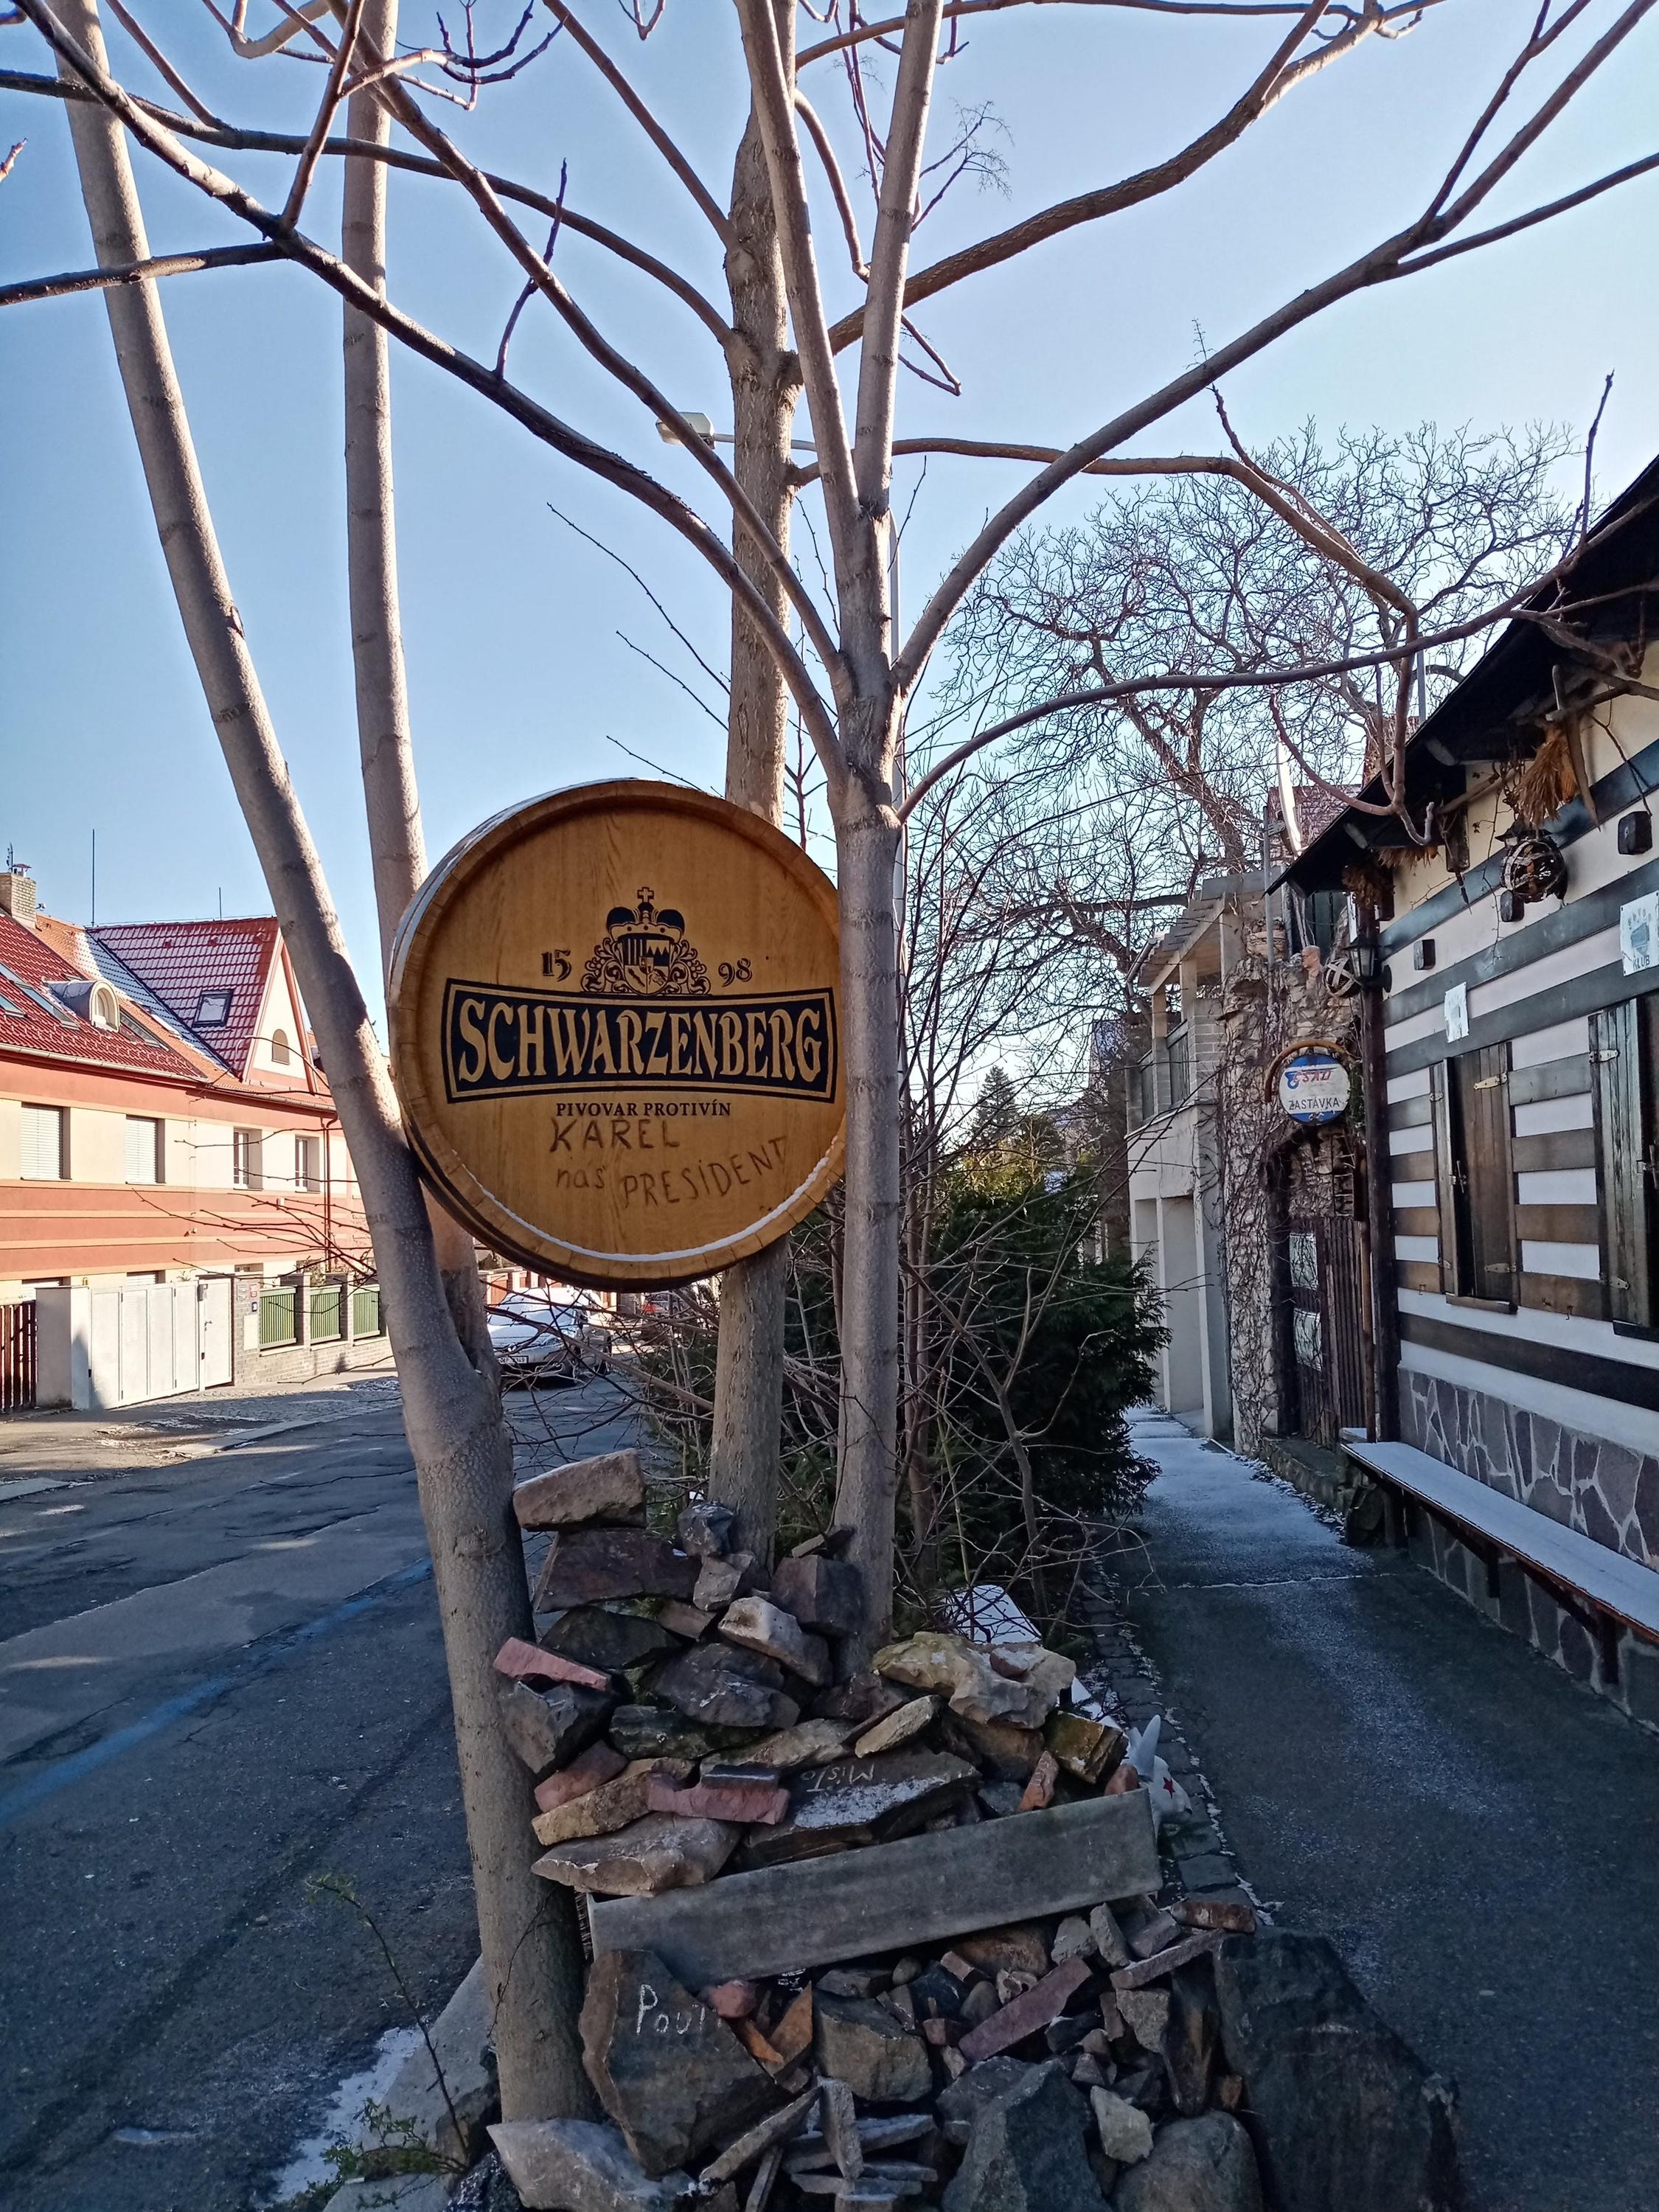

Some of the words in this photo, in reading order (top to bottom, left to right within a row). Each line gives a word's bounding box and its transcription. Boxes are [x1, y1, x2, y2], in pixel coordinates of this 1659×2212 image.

[540, 949, 572, 983] 15
[717, 958, 753, 988] 98
[1632, 955, 1651, 970] KLUB
[458, 998, 822, 1082] SCHWARZENBERG
[555, 1102, 639, 1117] PIVOVAR
[643, 1099, 731, 1117] PROTIVÍN
[1288, 1096, 1340, 1110] ZASTÁVKA
[549, 1117, 681, 1153] KAREL
